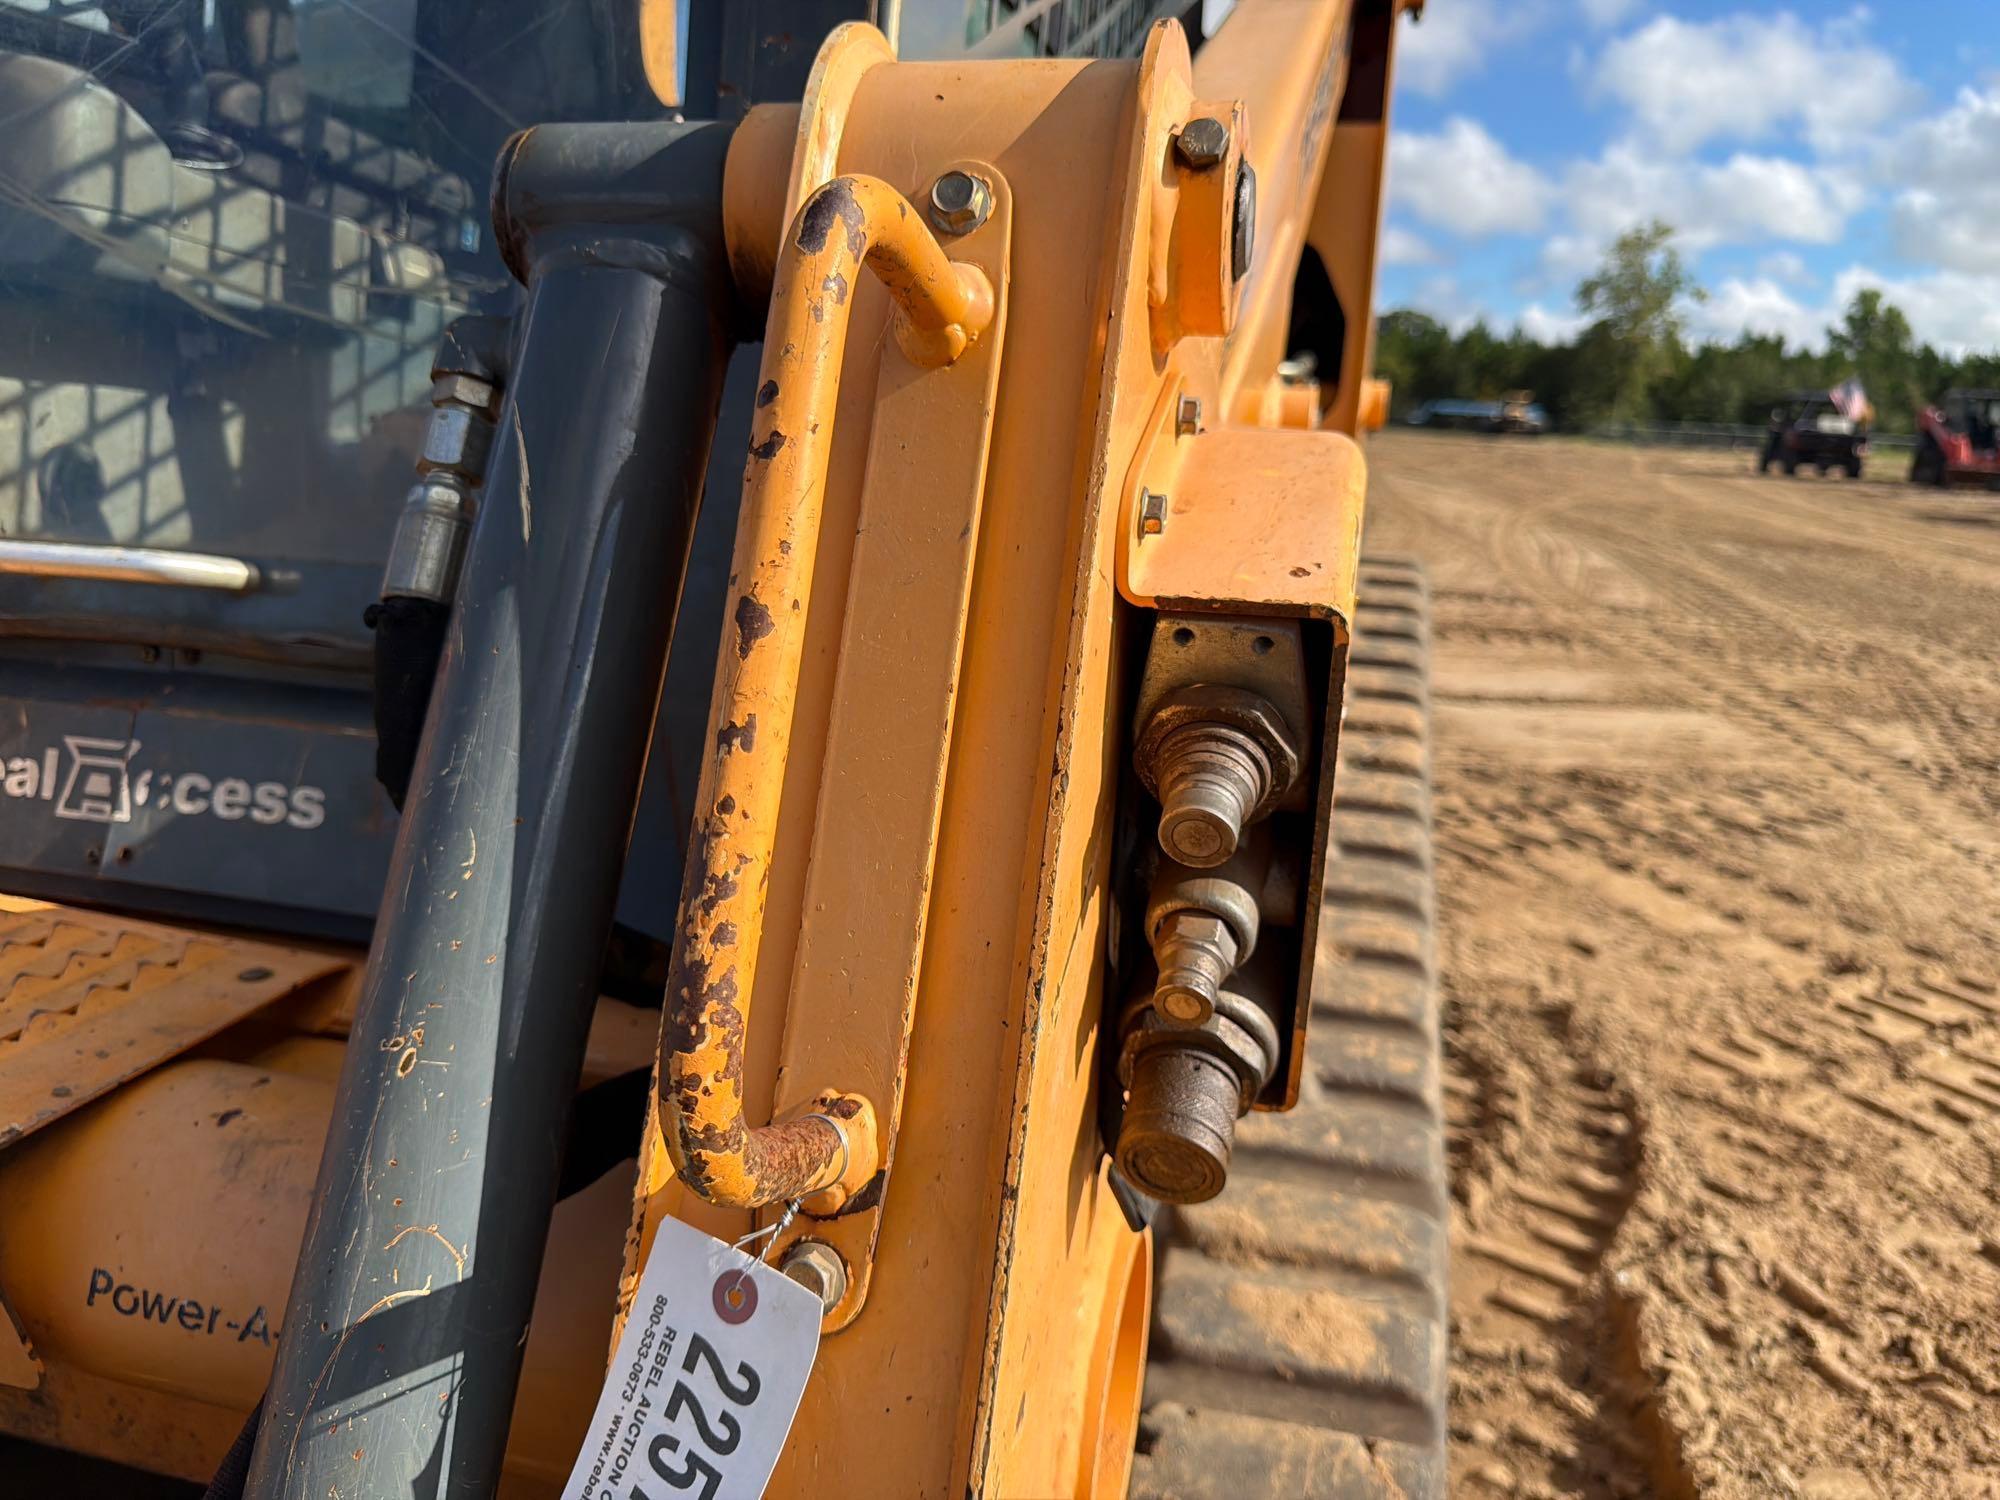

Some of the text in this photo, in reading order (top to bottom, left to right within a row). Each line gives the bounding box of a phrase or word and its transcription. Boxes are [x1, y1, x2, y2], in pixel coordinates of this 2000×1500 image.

[0, 747, 59, 801] al
[87, 1267, 280, 1347] Power-A
[621, 1294, 668, 1403] 800-533-0673
[644, 1326, 677, 1389] REBEL
[578, 1414, 624, 1500] www.rebel
[606, 1394, 652, 1487] AUCTION
[629, 1332, 761, 1500] 225
